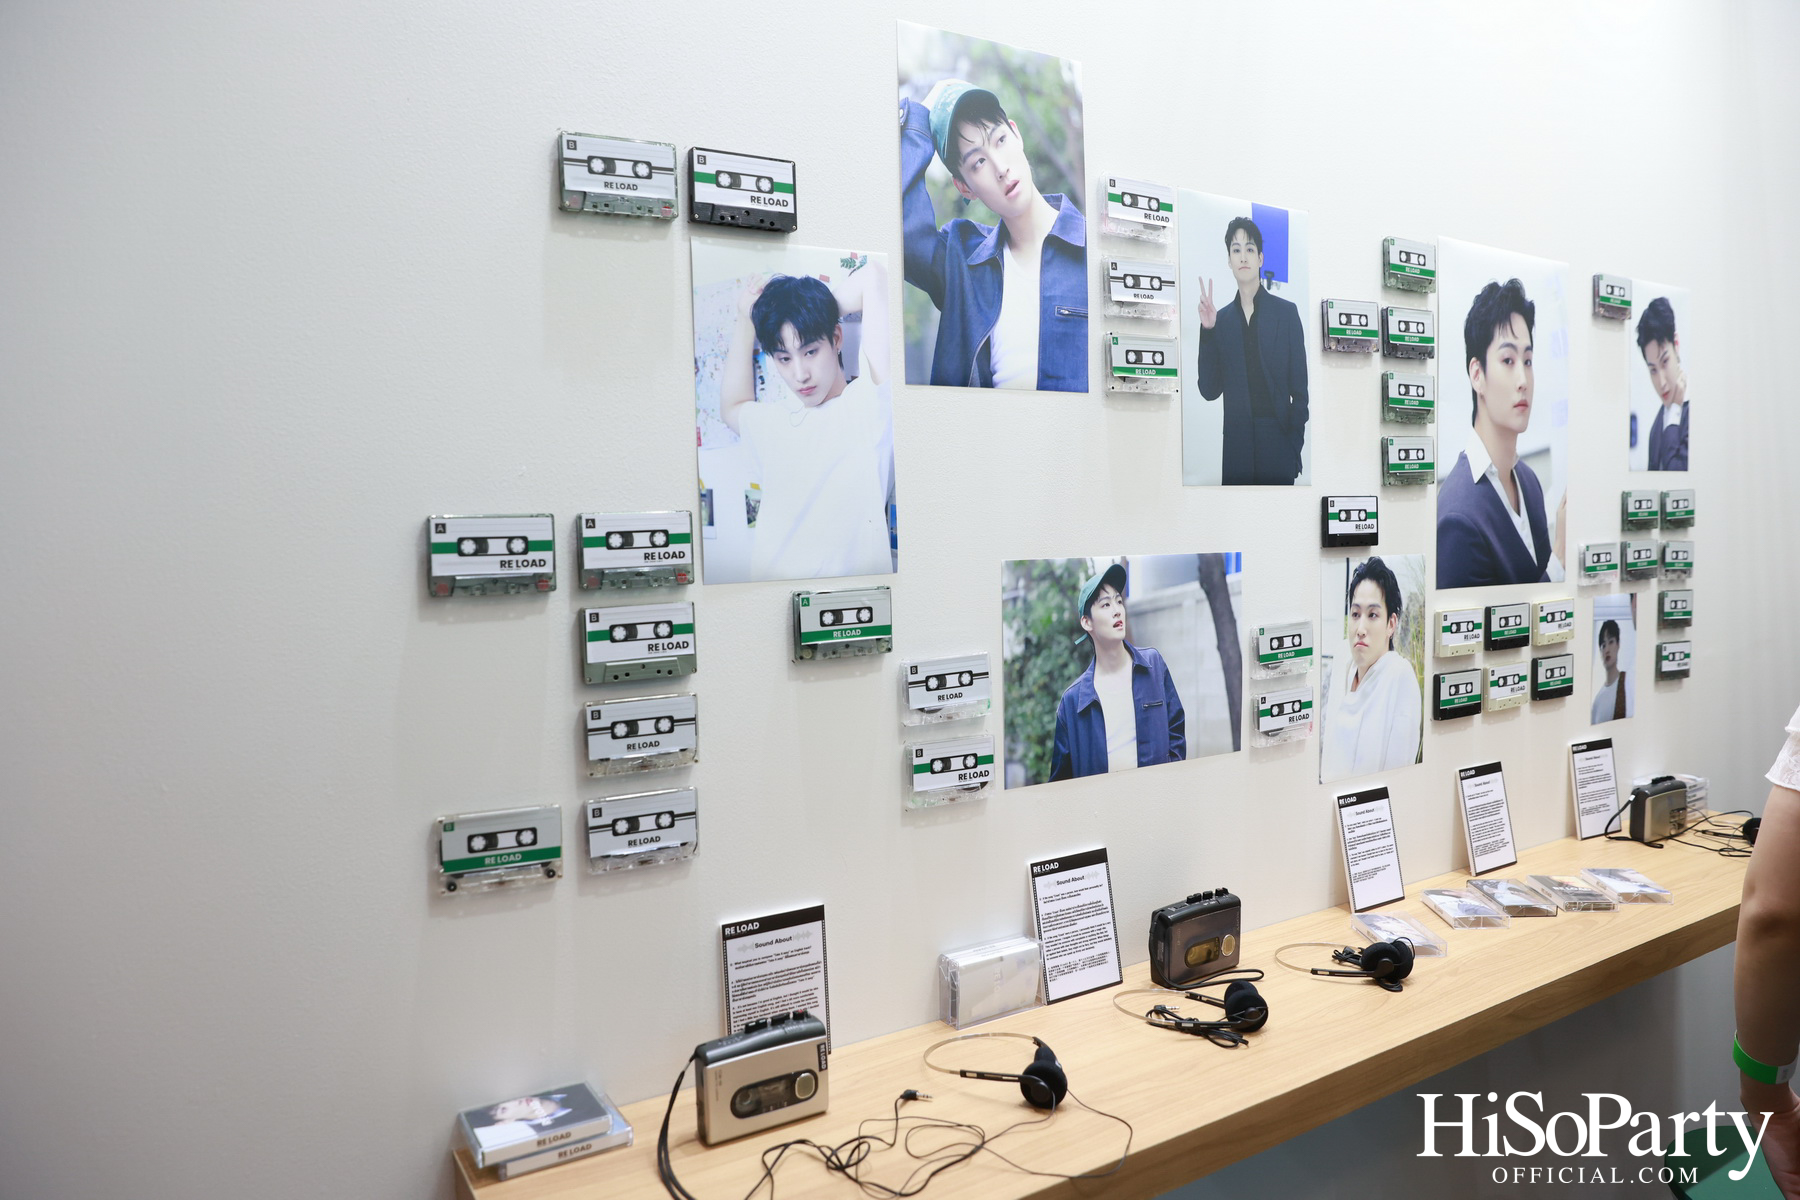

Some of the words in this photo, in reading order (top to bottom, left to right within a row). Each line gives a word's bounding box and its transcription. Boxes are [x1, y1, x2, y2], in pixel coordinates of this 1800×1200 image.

[615, 182, 638, 191] LOAD
[750, 195, 762, 204] RE
[763, 196, 789, 208] LOAD
[1152, 214, 1170, 223] LOAD
[644, 552, 656, 560] RE
[658, 550, 686, 560] LOAD
[500, 560, 514, 568] RE
[516, 558, 546, 568] LOAD
[842, 629, 862, 637] LOAD
[647, 643, 660, 652] RE
[662, 640, 689, 650] LOAD
[1296, 714, 1310, 722] LOAD
[627, 742, 636, 750] RE
[638, 740, 660, 750] LOAD
[958, 773, 968, 781] RE
[969, 770, 990, 780] LOAD
[628, 838, 637, 846] RE
[639, 836, 661, 846] LOAD
[484, 857, 496, 865] RE
[497, 854, 522, 864] LOAD
[1032, 865, 1042, 874] RE
[1042, 862, 1059, 872] LOAD
[1056, 878, 1070, 886] Sound
[1072, 875, 1084, 883] About
[725, 926, 736, 936] RE
[736, 922, 760, 933] LOAD
[755, 940, 774, 948] Sound
[775, 936, 792, 944] About
[536, 1138, 548, 1146] RE
[549, 1132, 572, 1144] LOAD
[558, 1150, 568, 1158] RE
[570, 1144, 592, 1154] LOAD
